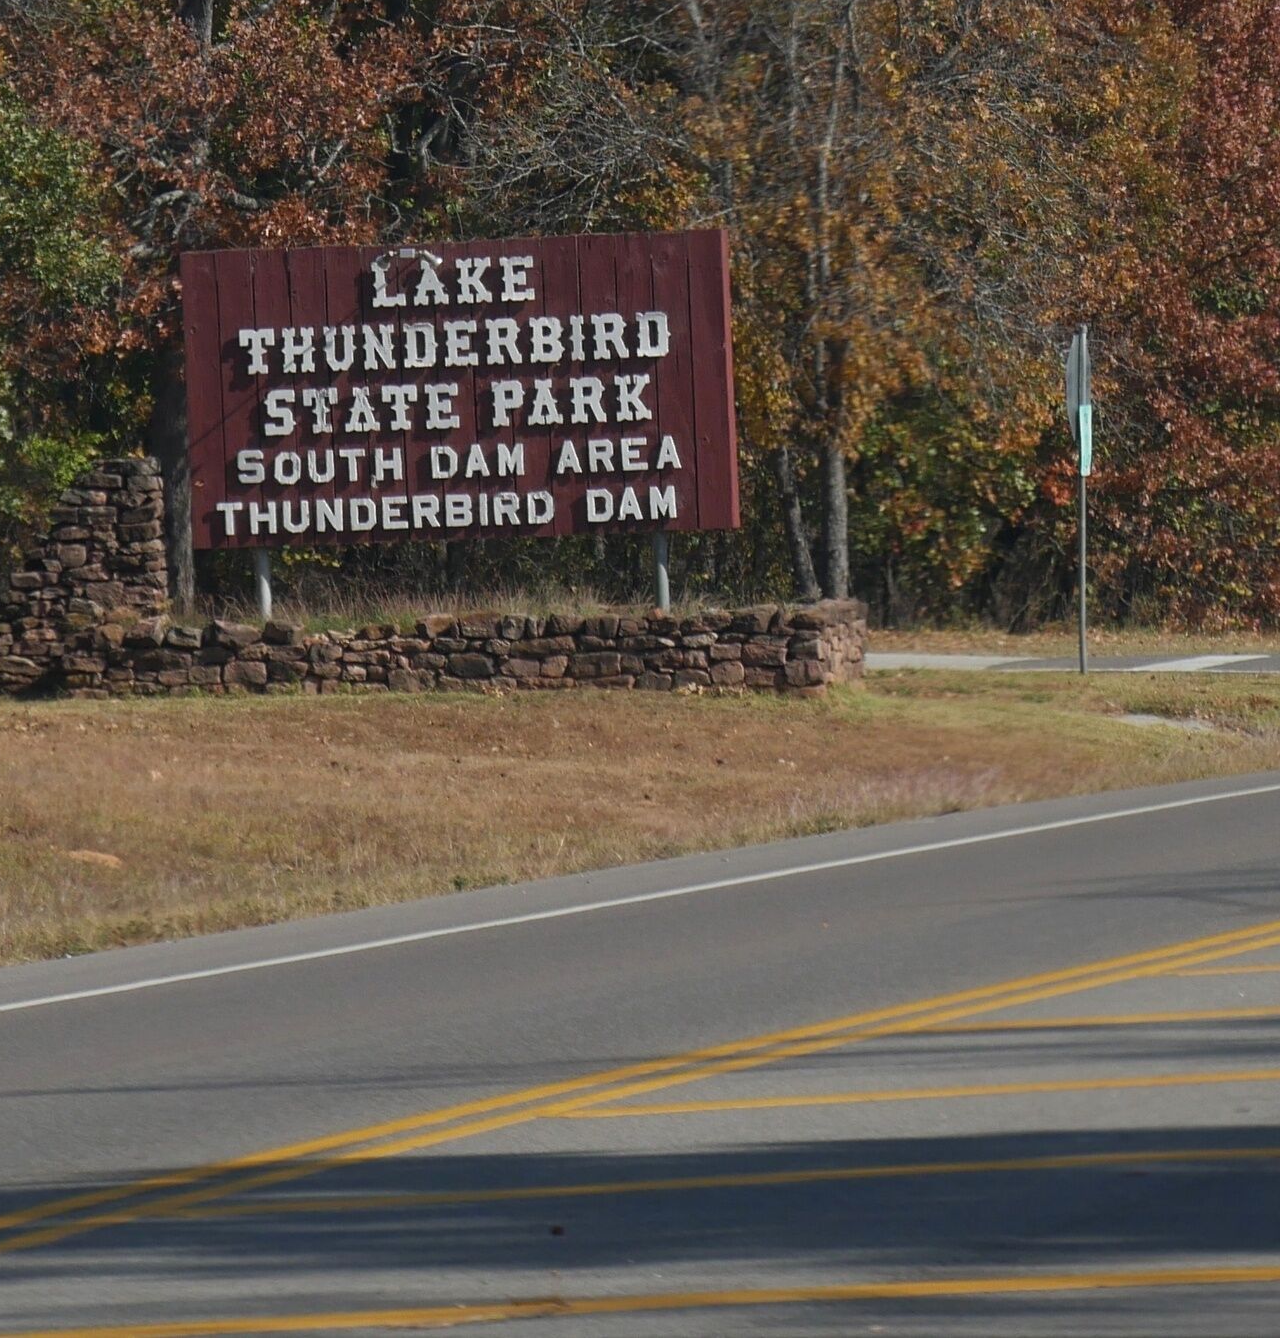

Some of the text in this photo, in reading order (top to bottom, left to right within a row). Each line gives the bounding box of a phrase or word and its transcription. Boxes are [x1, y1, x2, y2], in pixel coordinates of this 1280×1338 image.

[371, 256, 536, 309] LAKE
[238, 311, 672, 375] THUNDERBIRD
[263, 373, 653, 437] STATE PARK
[237, 435, 682, 485] SOUTH DAM AREA
[216, 485, 679, 537] THUNDERBIRD DAM
